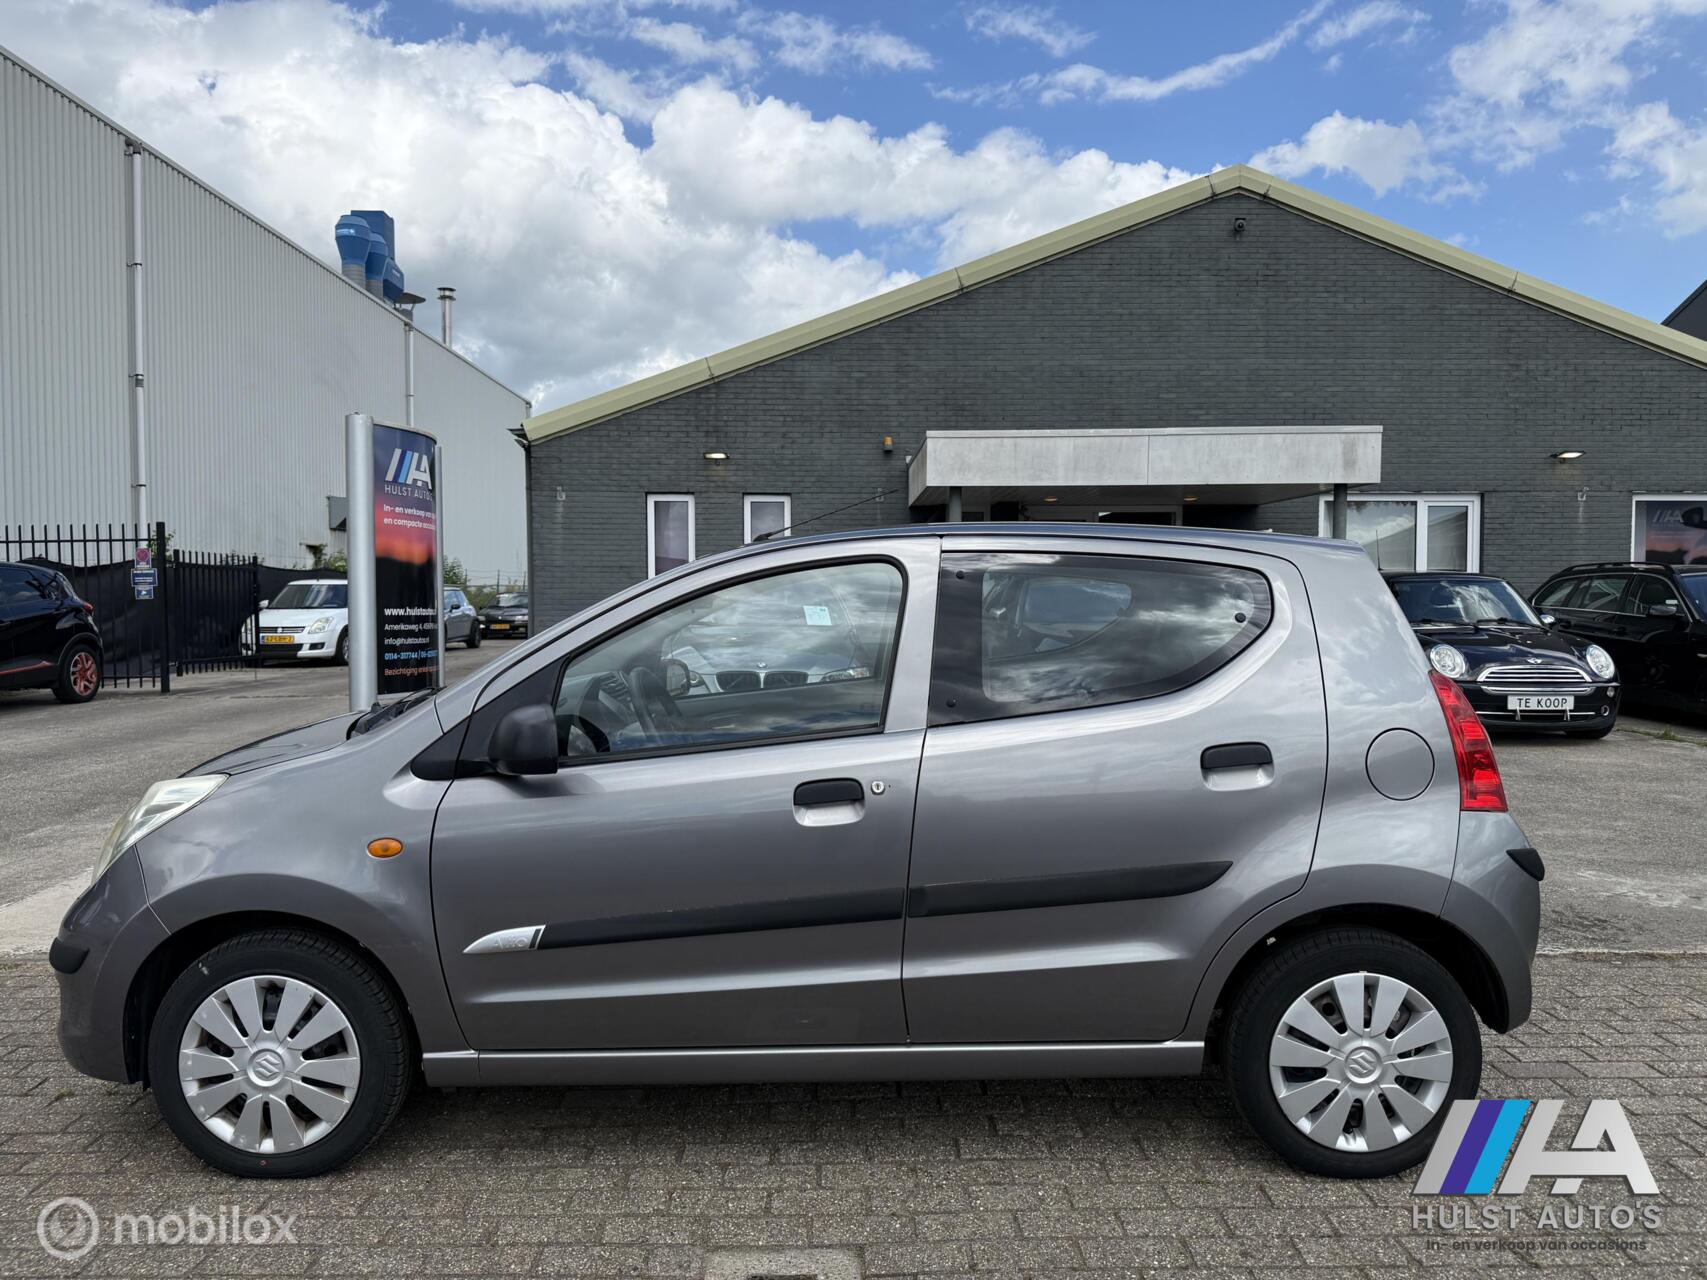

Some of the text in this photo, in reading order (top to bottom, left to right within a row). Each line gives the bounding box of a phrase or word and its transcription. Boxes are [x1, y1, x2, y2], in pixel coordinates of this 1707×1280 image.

[384, 484, 412, 497] HULST
[383, 503, 394, 512] In-
[395, 505, 404, 513] en
[383, 517, 393, 525] en
[1517, 697, 1568, 708] TE KOOP
